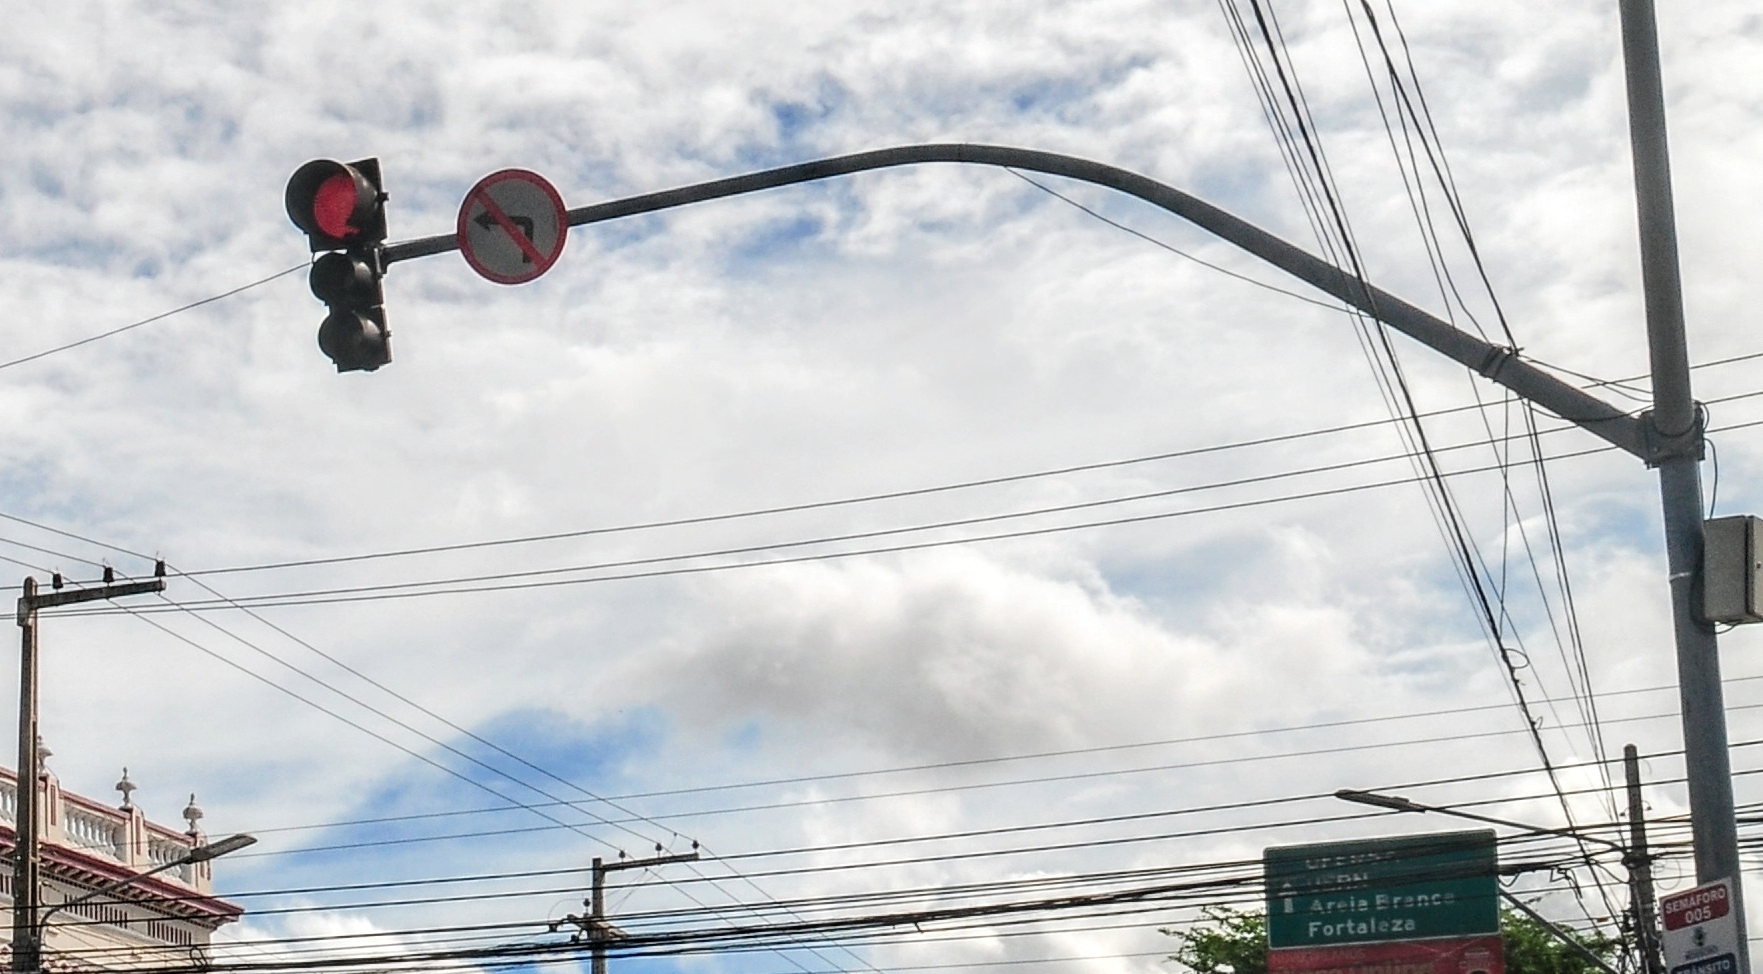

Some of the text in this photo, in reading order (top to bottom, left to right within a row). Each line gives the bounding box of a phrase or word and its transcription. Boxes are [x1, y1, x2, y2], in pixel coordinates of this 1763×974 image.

[1309, 890, 1456, 914] Areia Branca
[1685, 904, 1712, 924] 005
[1308, 917, 1416, 938] Fortaleza
